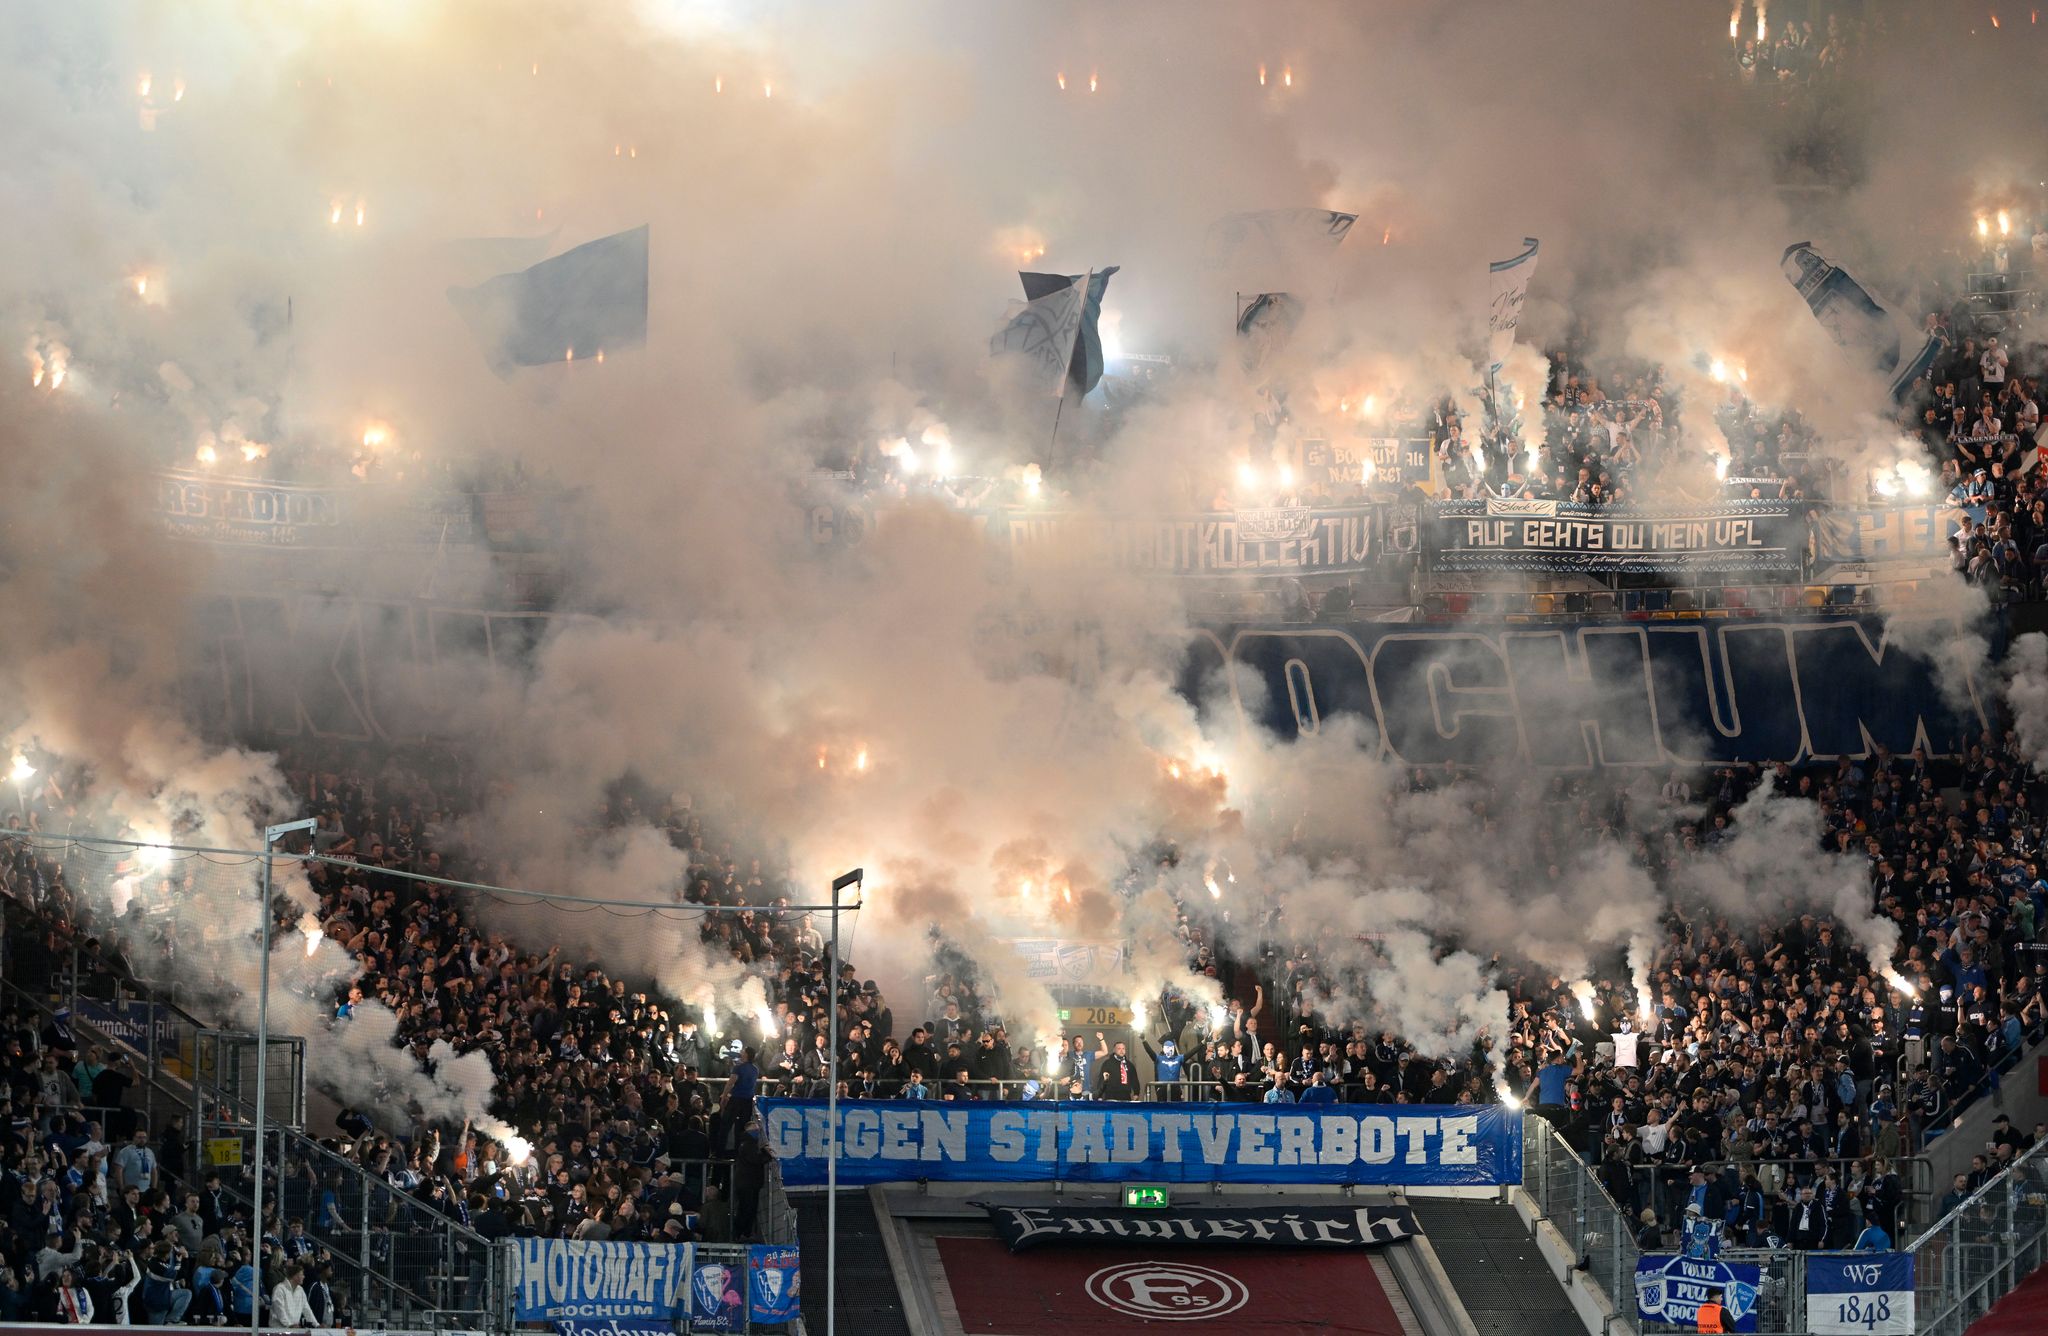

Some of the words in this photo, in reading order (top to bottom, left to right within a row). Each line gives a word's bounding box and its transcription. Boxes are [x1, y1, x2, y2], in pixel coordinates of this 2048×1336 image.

[1468, 520, 1515, 546] AUF
[1523, 520, 1604, 549] GEHTS
[1611, 524, 1644, 549] DU
[1652, 521, 1708, 550] MEIN
[1714, 519, 1762, 547] VFL
[1185, 620, 1990, 768] OCHUM
[768, 1107, 968, 1162] GEGEN
[989, 1111, 1478, 1166] STADTVERBOTE
[1000, 1207, 1403, 1245] Emmerich
[764, 1256, 800, 1269] BLOC
[1681, 1261, 1716, 1280] VOLLE
[546, 1304, 653, 1317] BOCHUM
[1838, 1293, 1891, 1331] 1848
